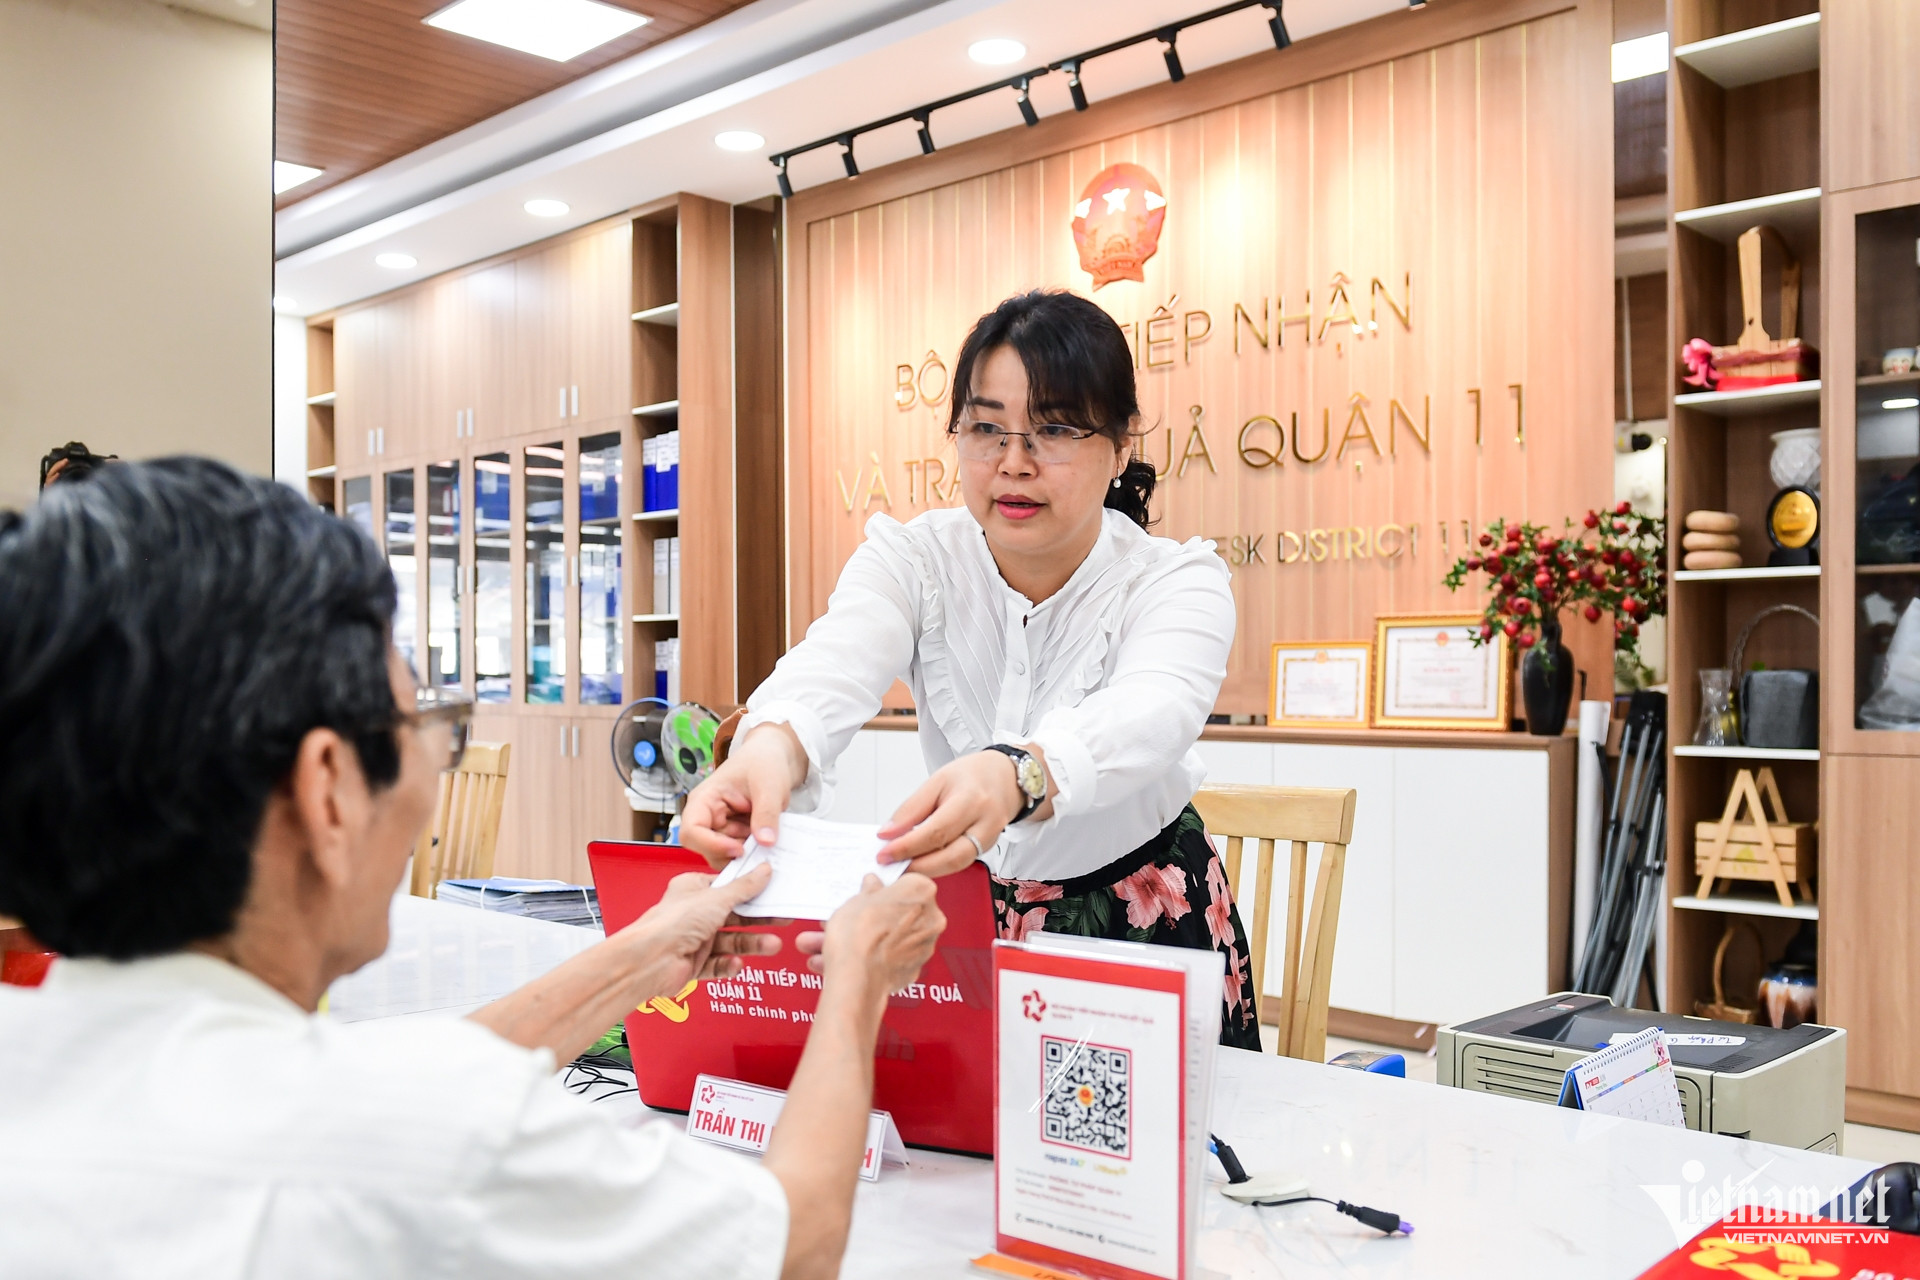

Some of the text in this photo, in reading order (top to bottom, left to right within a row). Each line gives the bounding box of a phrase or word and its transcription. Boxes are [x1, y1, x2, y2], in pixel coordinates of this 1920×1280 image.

[895, 348, 949, 420] BỘ
[1234, 271, 1413, 357] NHẬN
[834, 450, 893, 513] VÀ
[1140, 404, 1218, 481] UẢ
[1238, 391, 1432, 474] QUẬN
[1467, 384, 1528, 447] 11
[1277, 522, 1420, 564] DISTRICT
[1438, 520, 1472, 555] 11
[706, 977, 763, 1002] QUẬN 11
[733, 966, 765, 987] HẬN
[766, 967, 798, 987] TIẾP
[800, 973, 823, 990] NH
[929, 982, 964, 1004] QUẢ
[710, 1001, 744, 1015] Hành
[748, 1005, 787, 1020] chính
[694, 1107, 767, 1148] TRẦN THỊ
